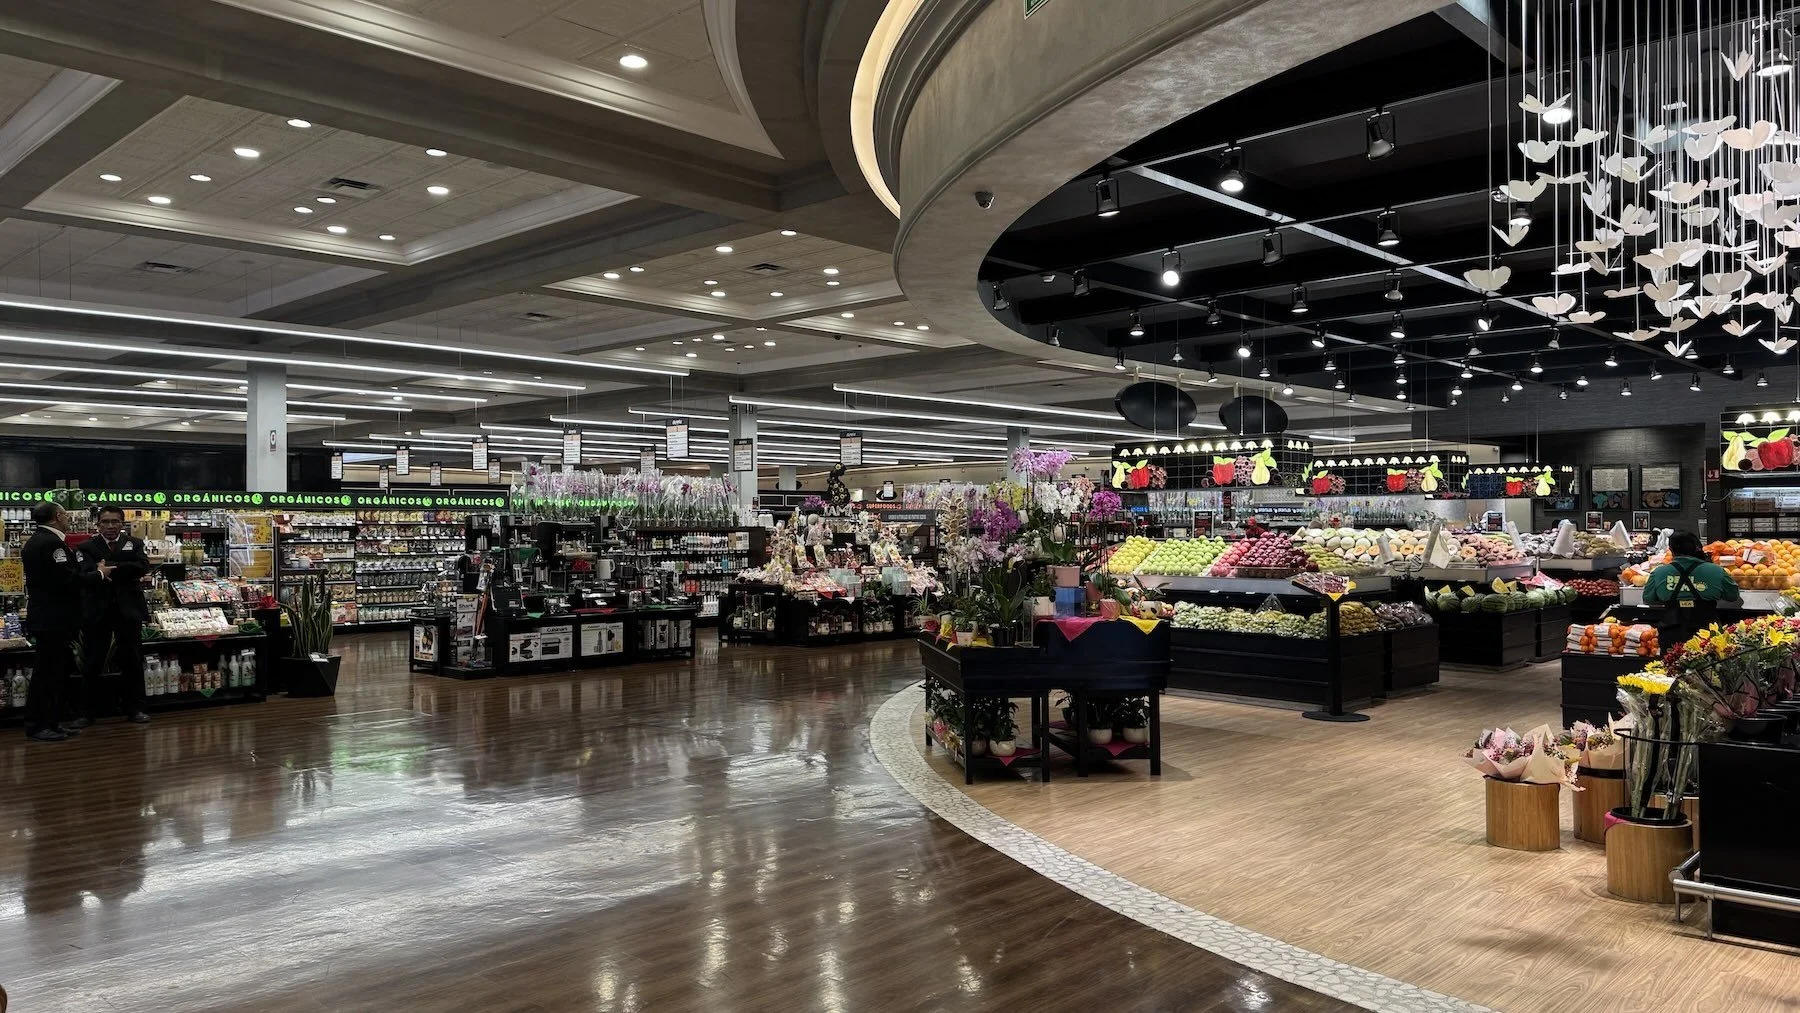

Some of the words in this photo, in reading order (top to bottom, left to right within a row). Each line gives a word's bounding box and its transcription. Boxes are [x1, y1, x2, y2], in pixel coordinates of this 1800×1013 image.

[173, 493, 251, 504] ORGÁNICOS
[269, 494, 340, 505] ORGÁNICOS
[357, 496, 422, 506] ORGÁNICOS
[435, 496, 495, 507] ORGÁNICOS
